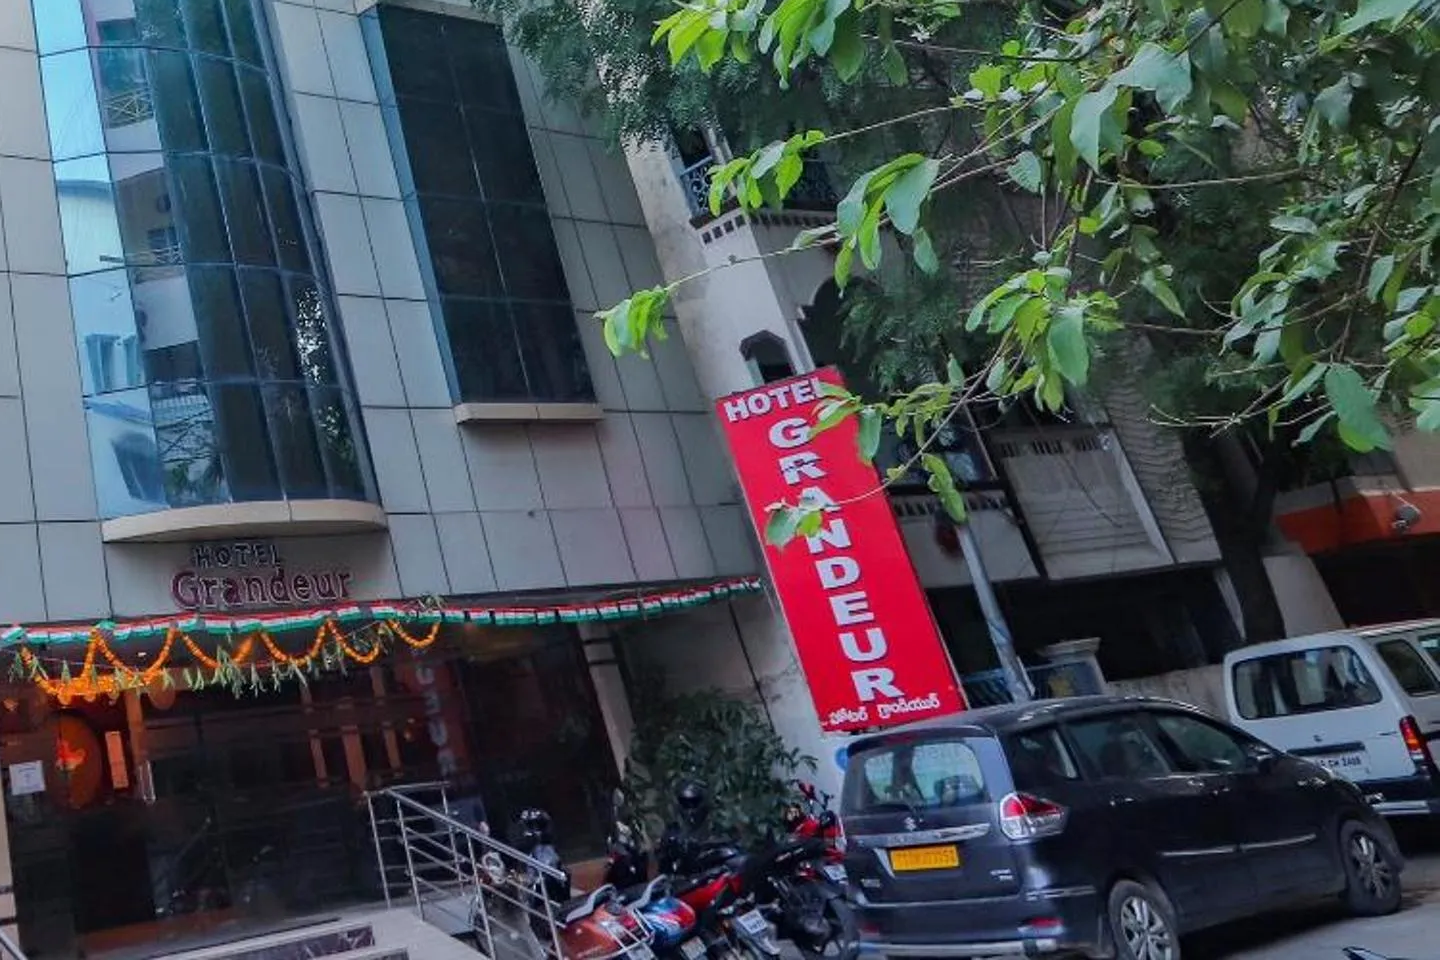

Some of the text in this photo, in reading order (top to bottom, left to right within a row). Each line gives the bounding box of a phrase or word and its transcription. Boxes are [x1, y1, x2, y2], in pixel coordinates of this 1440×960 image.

[725, 376, 822, 421] HOTEL
[195, 542, 281, 569] HOTEL
[172, 568, 351, 609] Grandeur
